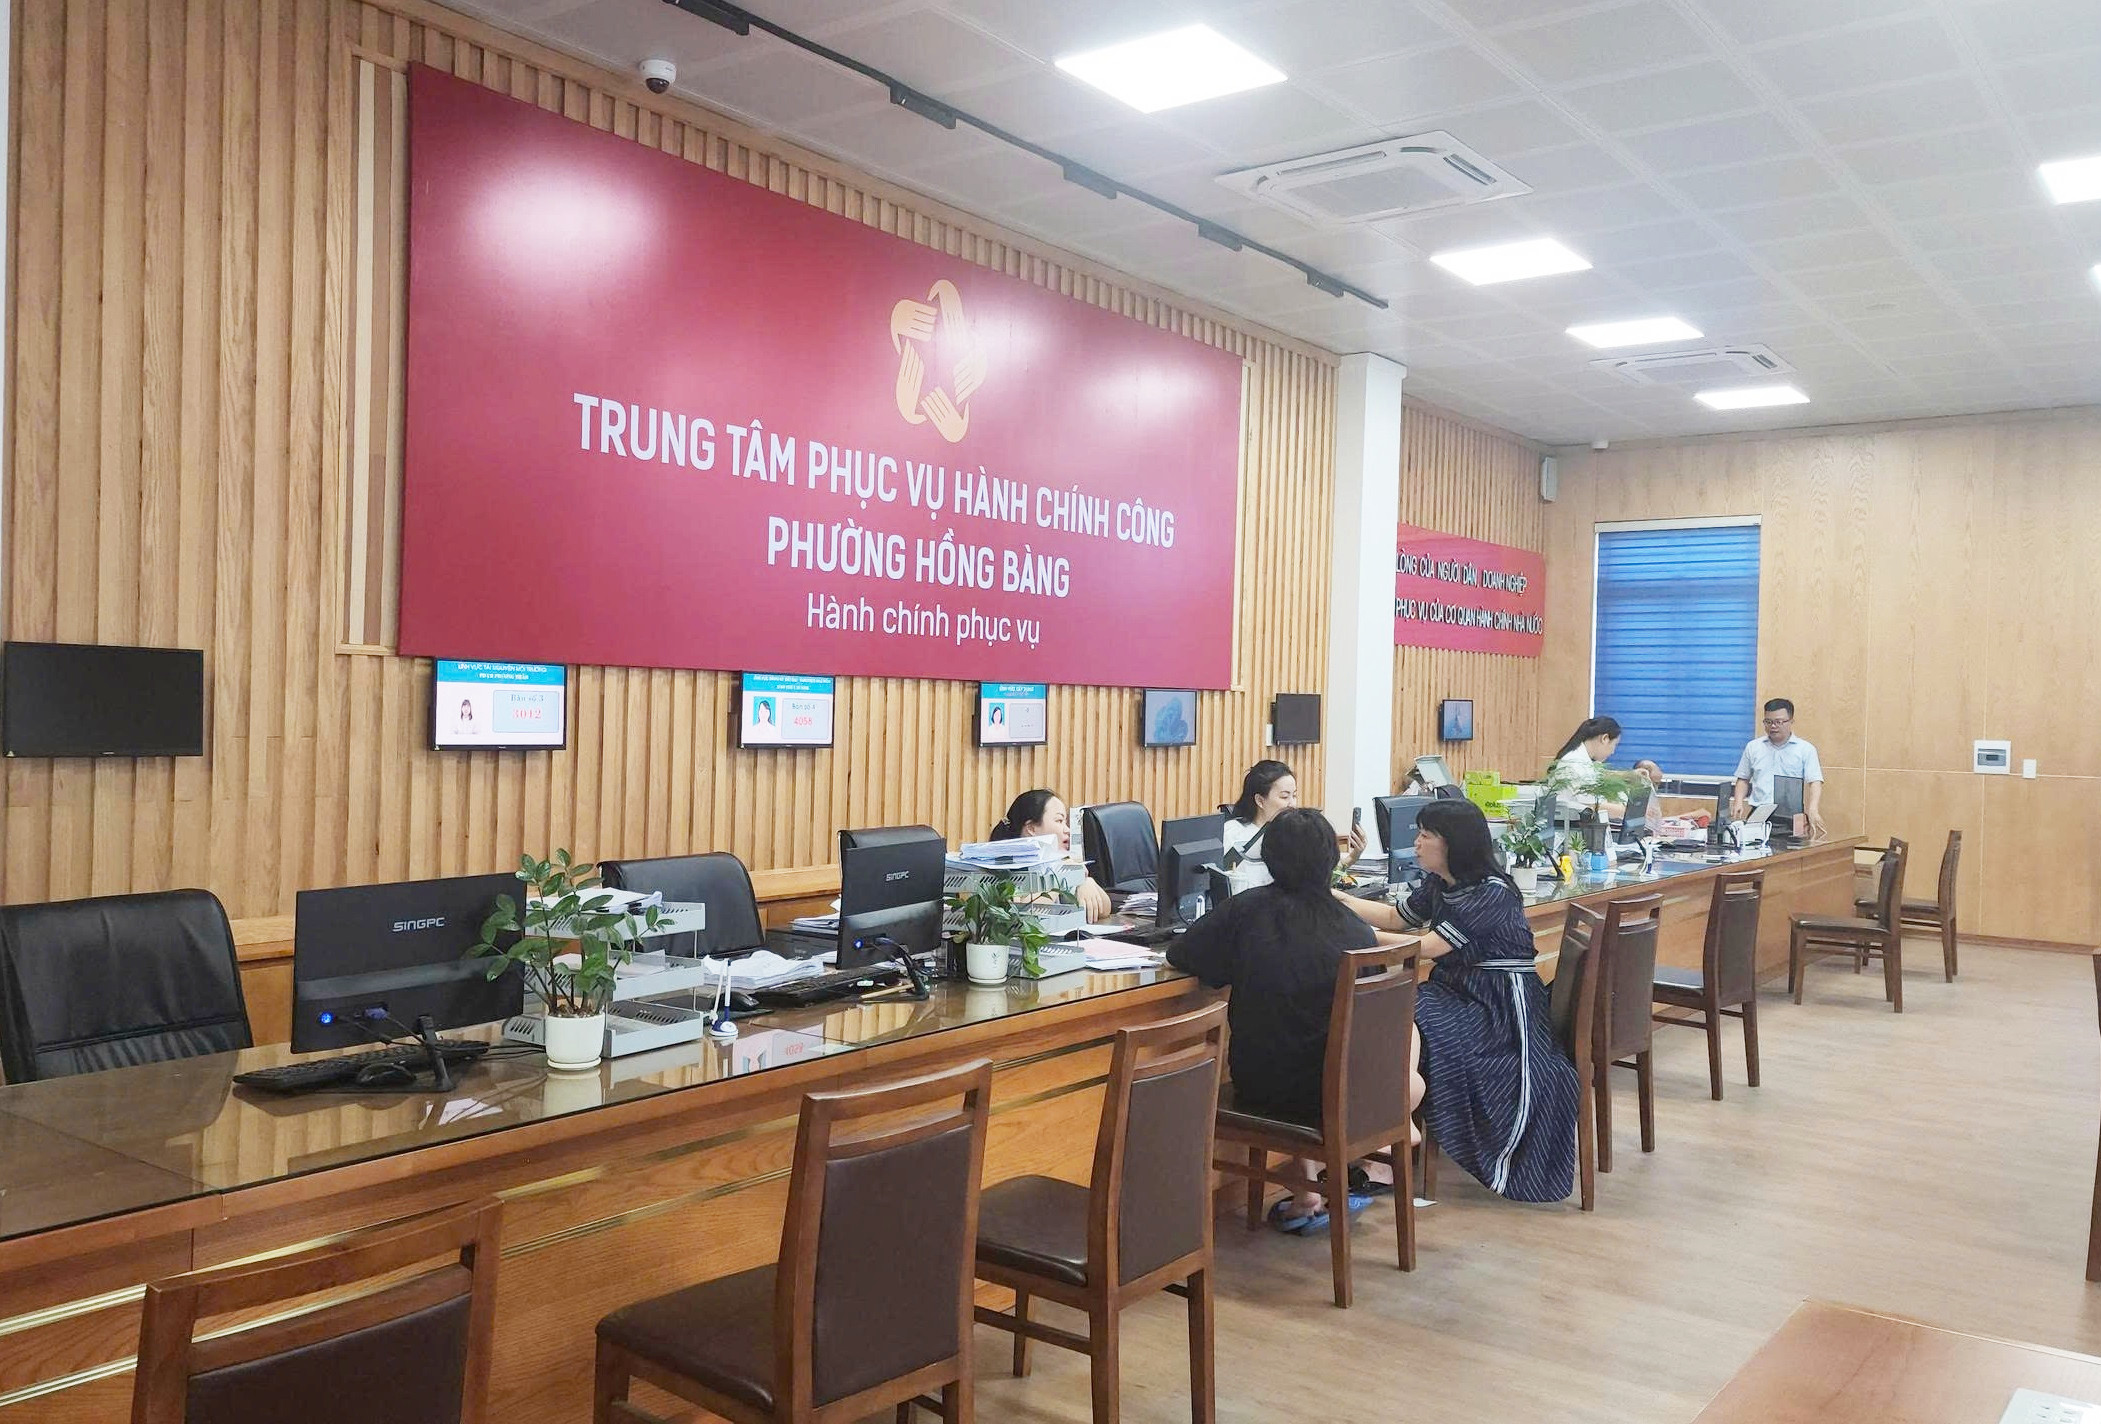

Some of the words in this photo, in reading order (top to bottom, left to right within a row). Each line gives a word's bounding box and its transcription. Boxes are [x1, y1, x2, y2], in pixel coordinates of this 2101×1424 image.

[573, 392, 716, 471] TRUNG
[726, 418, 796, 486] TÂM
[808, 440, 898, 510] PHỤC
[905, 460, 945, 521] VỤ
[954, 465, 1028, 525] HÀNH
[1035, 484, 1110, 538] CHÍNH
[1116, 497, 1175, 549] CÔNG
[767, 516, 906, 581] PHƯỜNG
[915, 527, 995, 590] HỒNG
[1002, 544, 1070, 598] BÀNG
[1396, 547, 1418, 576] LÒNG
[1420, 552, 1435, 578] CỦA
[1437, 558, 1460, 582] NGƯỜI
[1482, 569, 1505, 591] DOANH
[1506, 571, 1527, 597] NGHIỆP
[807, 592, 875, 632] Hành
[882, 597, 950, 638] chính
[956, 607, 1011, 647] phục
[1016, 618, 1040, 650] vụ
[1395, 597, 1416, 622] PHỤC
[1418, 600, 1429, 625] VỤ
[1429, 597, 1444, 623] CỦA
[1445, 603, 1457, 625] CƠ
[1457, 606, 1476, 628] QUAN
[1476, 605, 1493, 629] HÀNH
[1494, 607, 1512, 632] CHÍNH
[1512, 610, 1526, 633] NHÀ
[1526, 609, 1543, 636] NƯỚC
[885, 870, 910, 882] SINGPC
[392, 916, 446, 933] SINGPC
